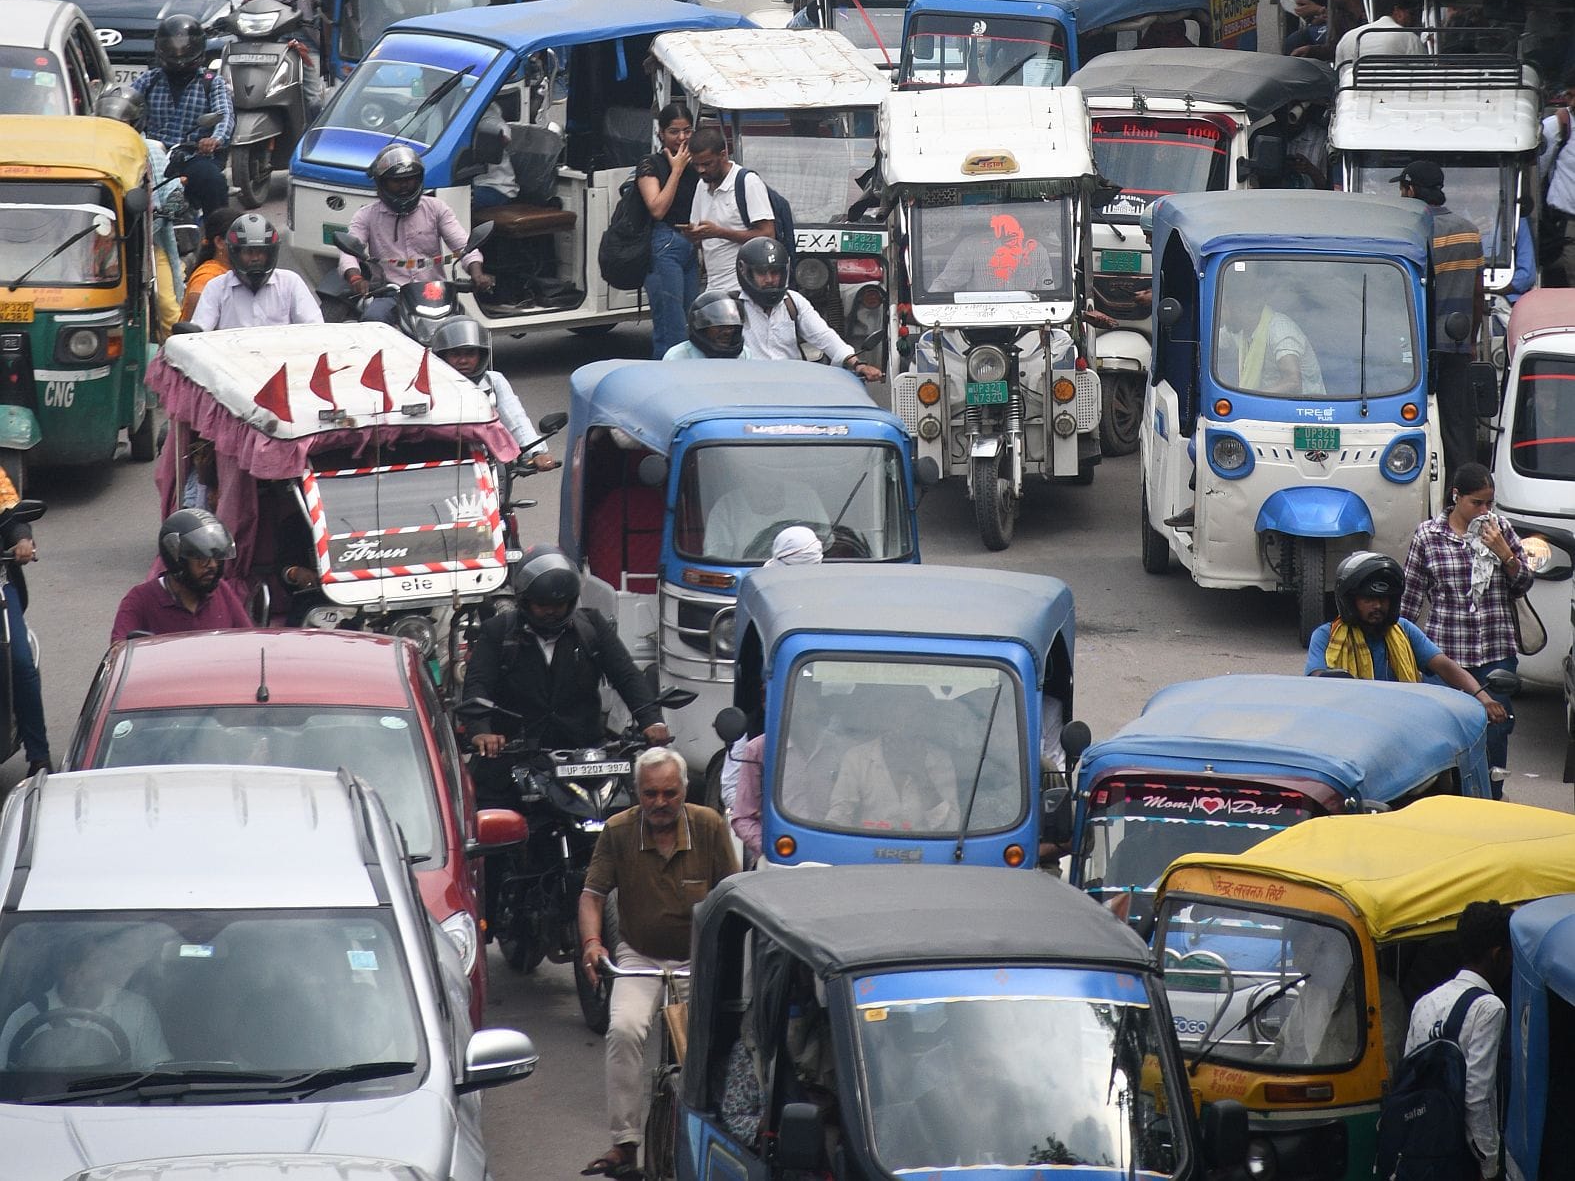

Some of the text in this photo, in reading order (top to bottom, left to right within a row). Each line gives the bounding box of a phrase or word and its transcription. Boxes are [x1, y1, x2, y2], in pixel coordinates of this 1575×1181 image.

[115, 70, 144, 83] 576
[1123, 124, 1160, 138] khan
[1185, 127, 1221, 142] 1090
[44, 380, 75, 407] CNG
[1305, 439, 1336, 449] T5072
[567, 766, 578, 775] UP
[1143, 795, 1283, 815] Mom Dad
